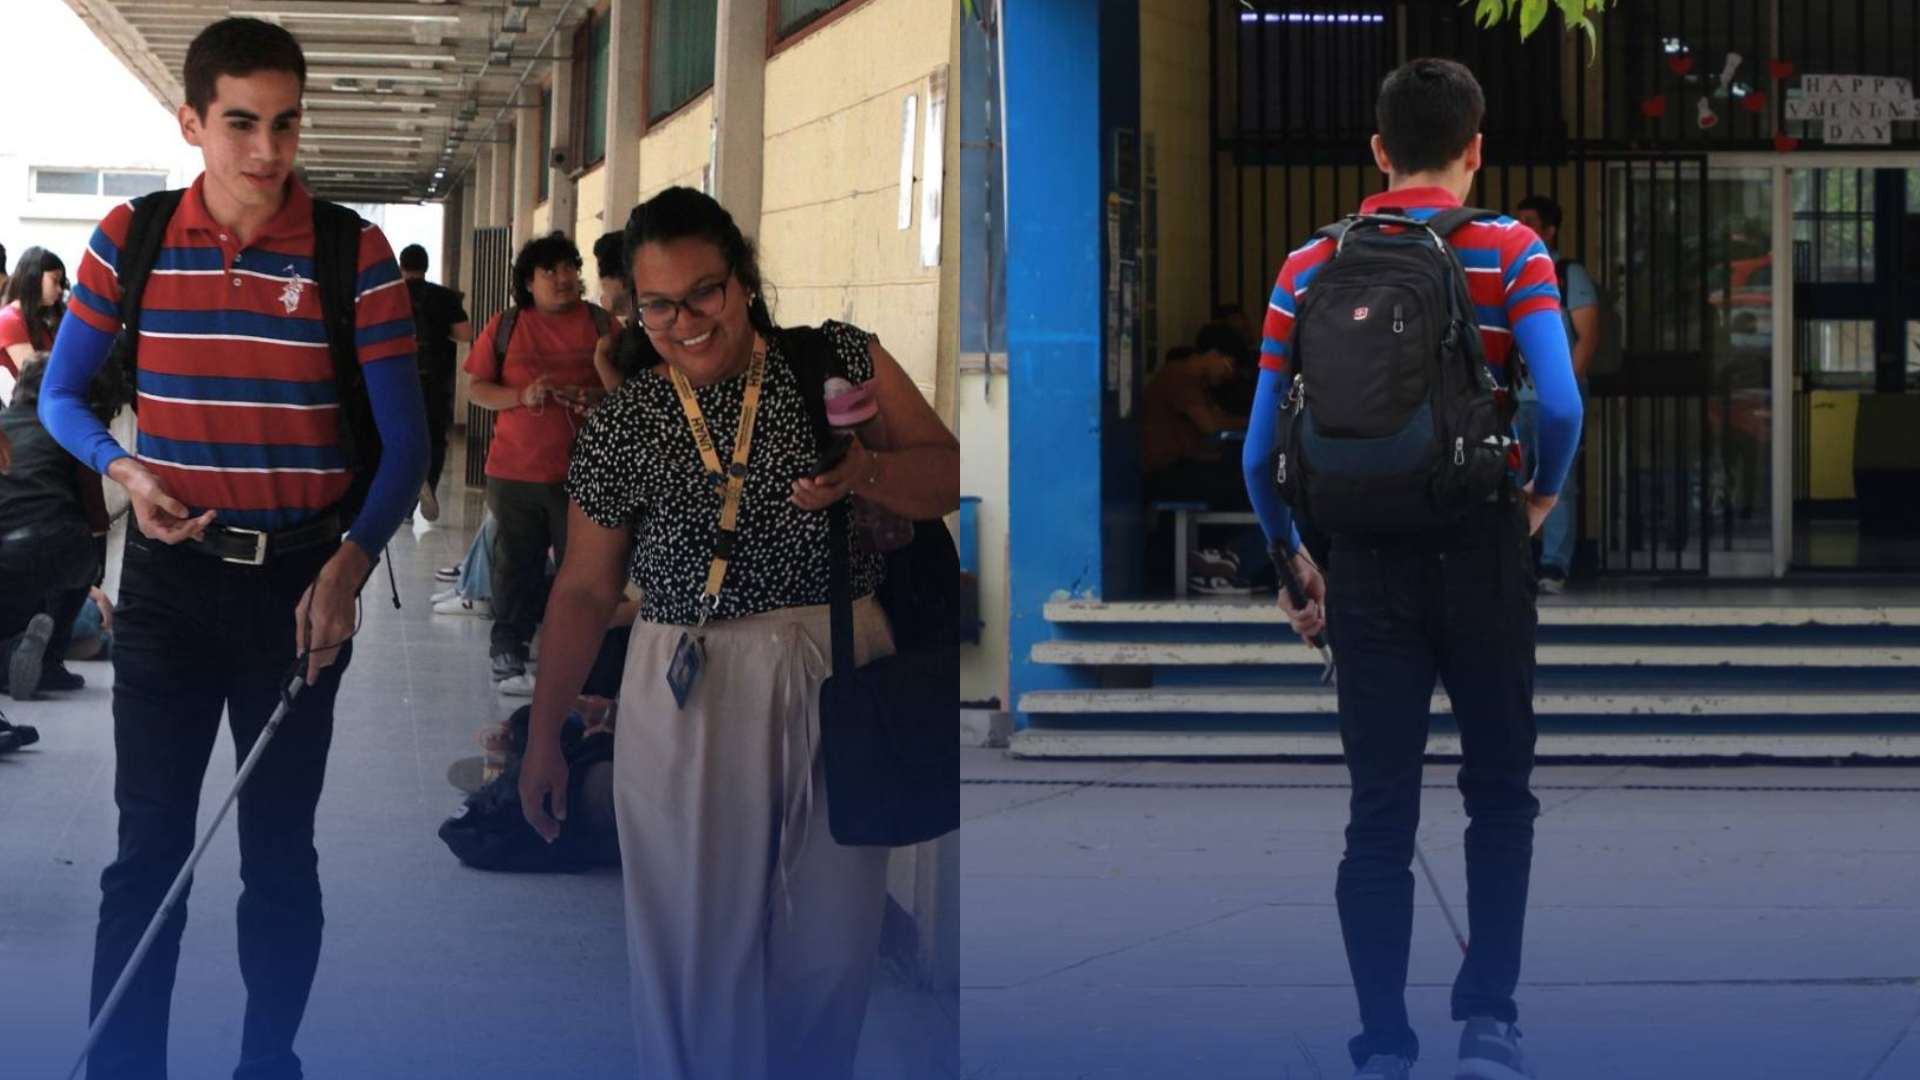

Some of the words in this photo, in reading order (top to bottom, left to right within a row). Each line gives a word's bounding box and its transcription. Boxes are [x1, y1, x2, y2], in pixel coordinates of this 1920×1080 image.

[1806, 77, 1908, 94] HAPPY
[1830, 125, 1887, 139] DAY
[691, 417, 713, 453] UNAH
